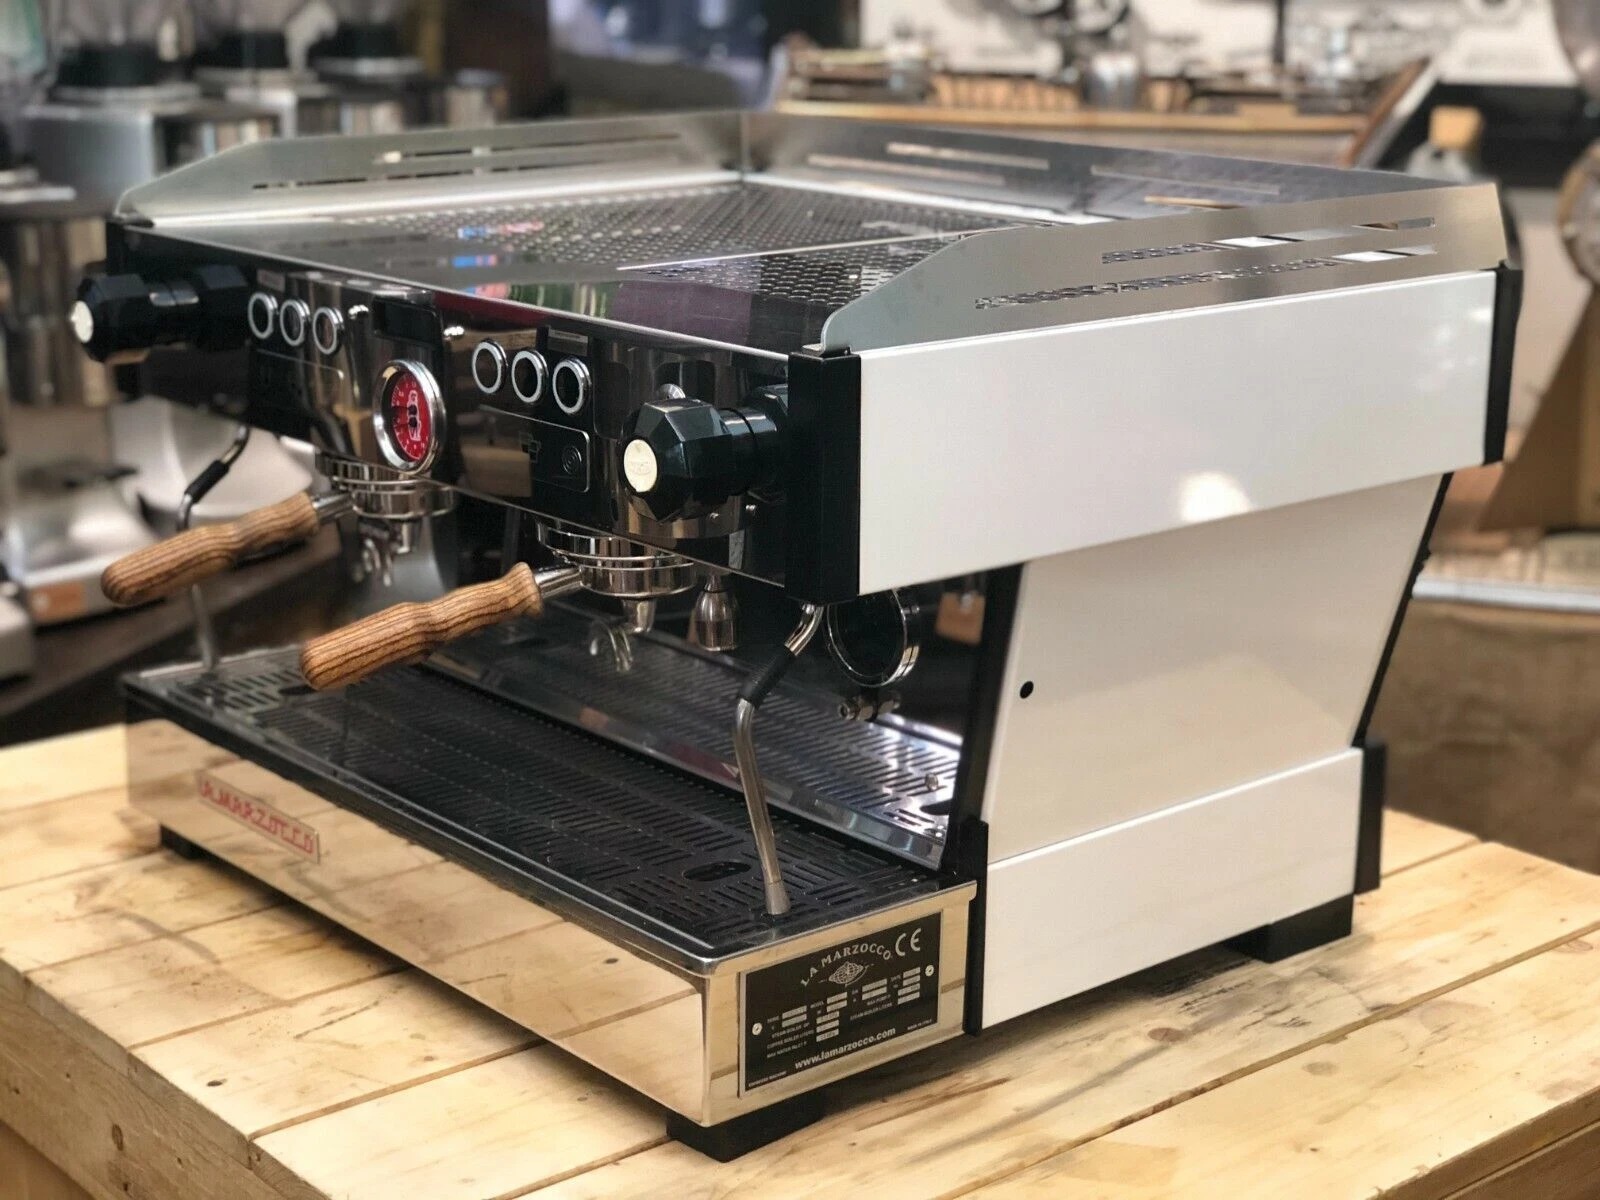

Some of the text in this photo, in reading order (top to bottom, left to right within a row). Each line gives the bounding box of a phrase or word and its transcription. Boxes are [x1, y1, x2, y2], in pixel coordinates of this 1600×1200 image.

[895, 928, 922, 956] CE
[800, 943, 891, 987] LA MARZOCCO
[795, 1028, 896, 1069] www.lamarzocco.com
